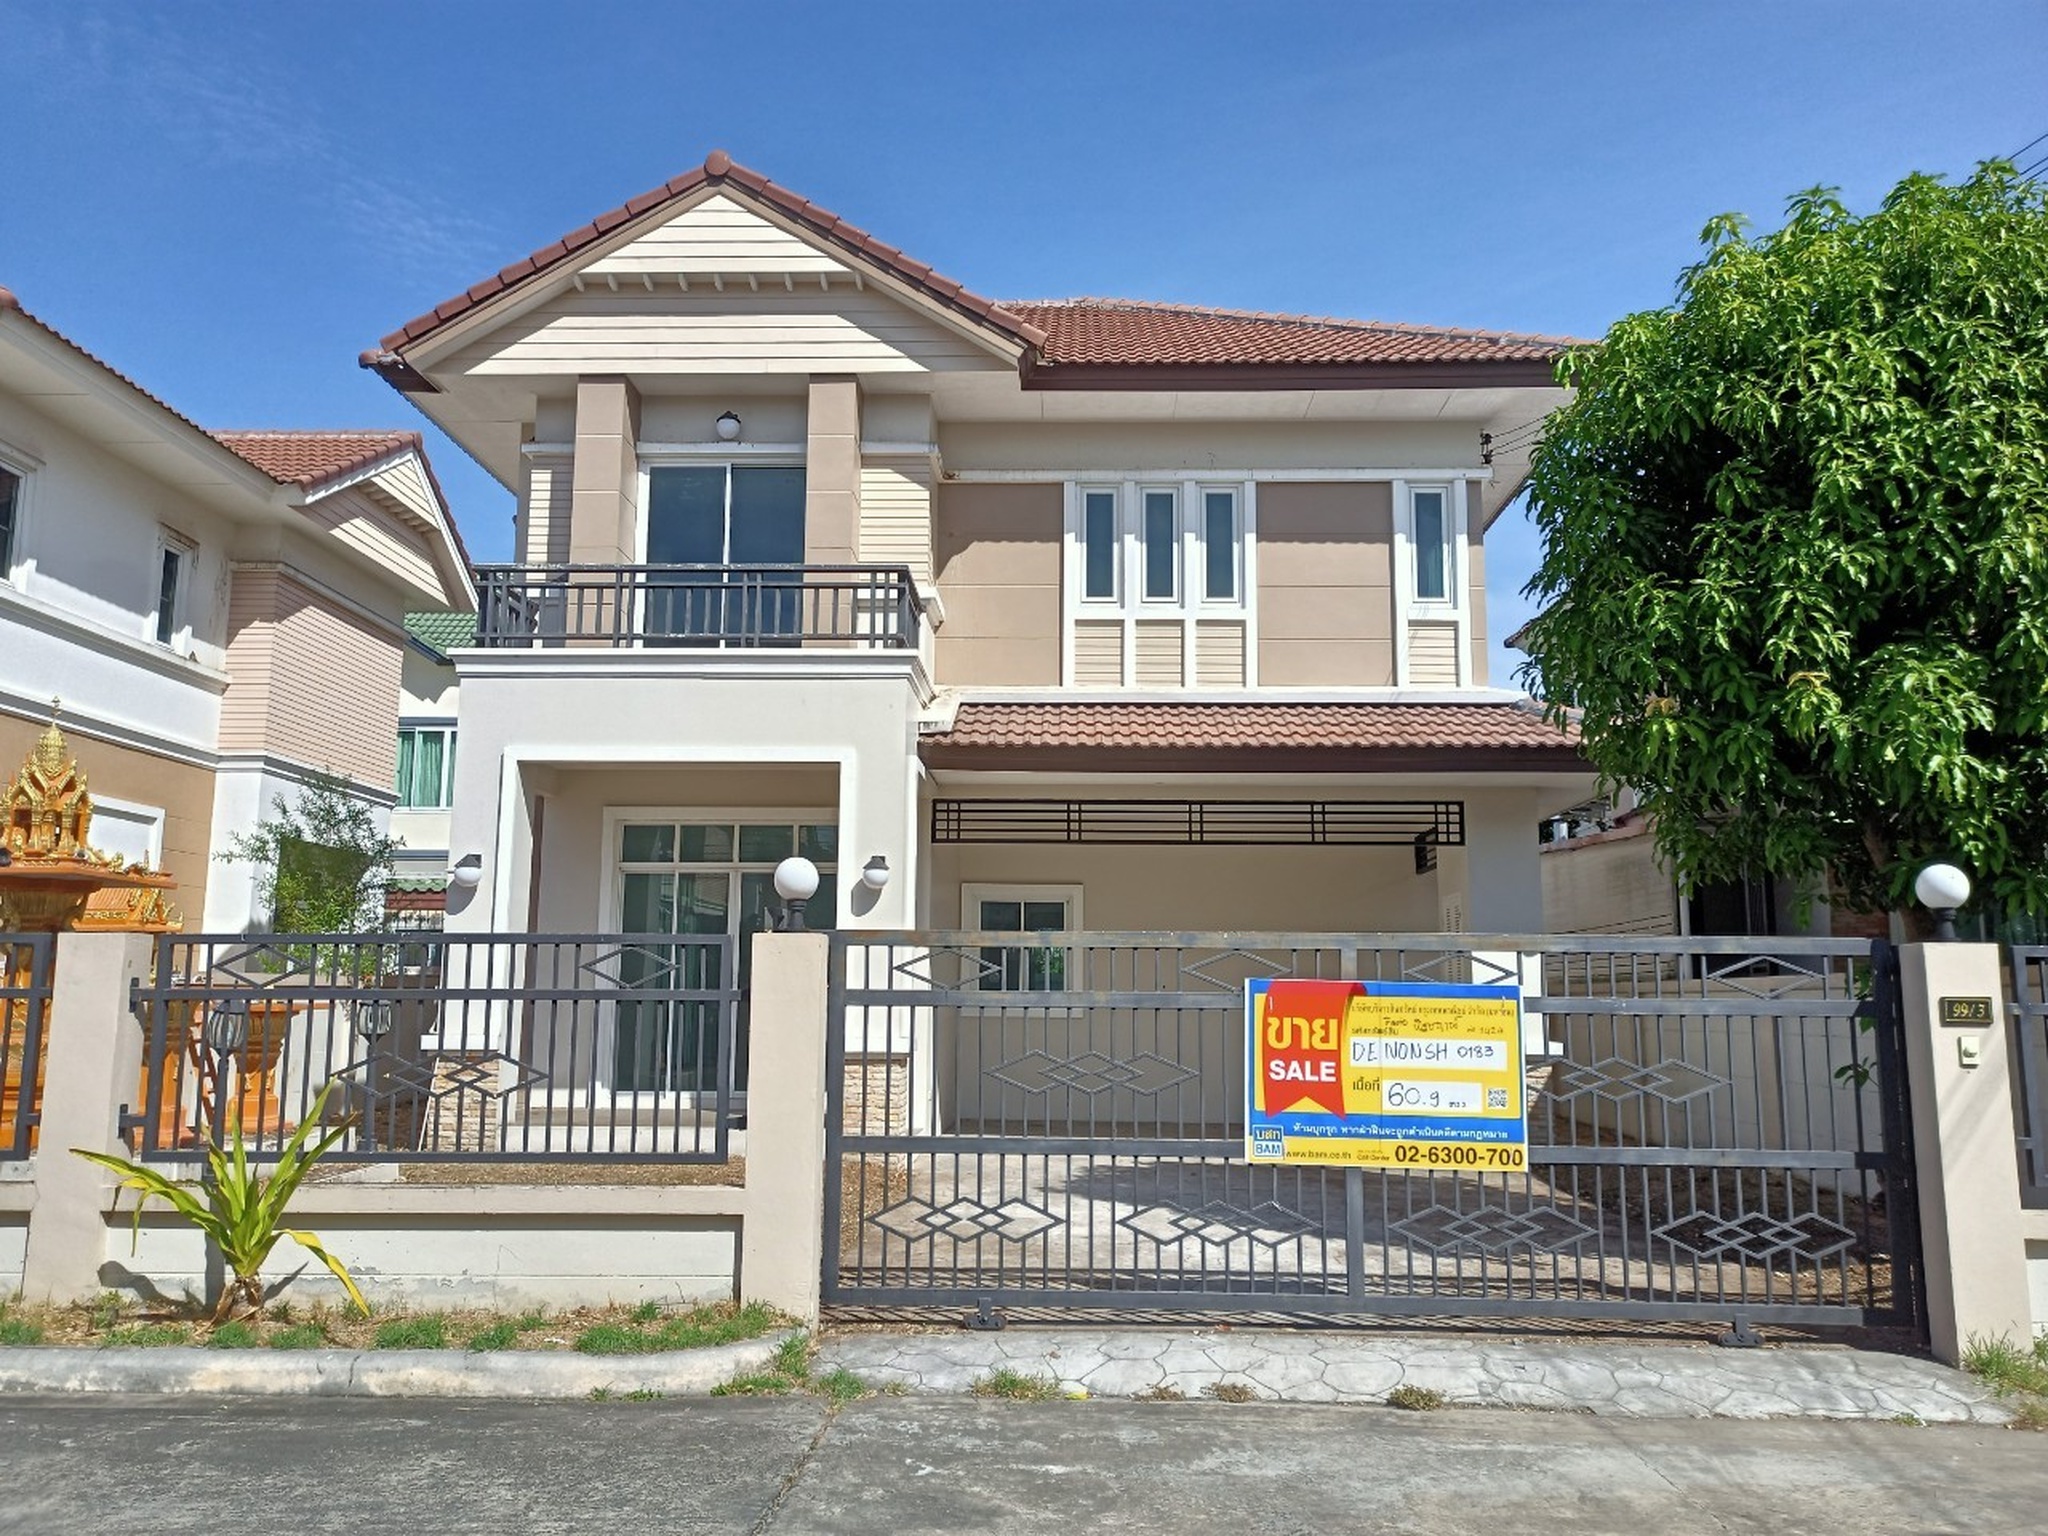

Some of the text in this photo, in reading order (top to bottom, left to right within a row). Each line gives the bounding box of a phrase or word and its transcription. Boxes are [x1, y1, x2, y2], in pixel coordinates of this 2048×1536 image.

[1953, 1003, 1985, 1018] 99/3
[1267, 1017, 1338, 1050] ขาย
[1457, 1045, 1494, 1058] 0183
[1269, 1059, 1337, 1082] SALE
[1352, 1076, 1380, 1091] เนื้อที่
[1388, 1082, 1440, 1108] 60.9
[1293, 1122, 1338, 1136] ห้ามบุกรุก
[1255, 1143, 1281, 1154] BAM
[1395, 1145, 1523, 1166] 02-6300-700
